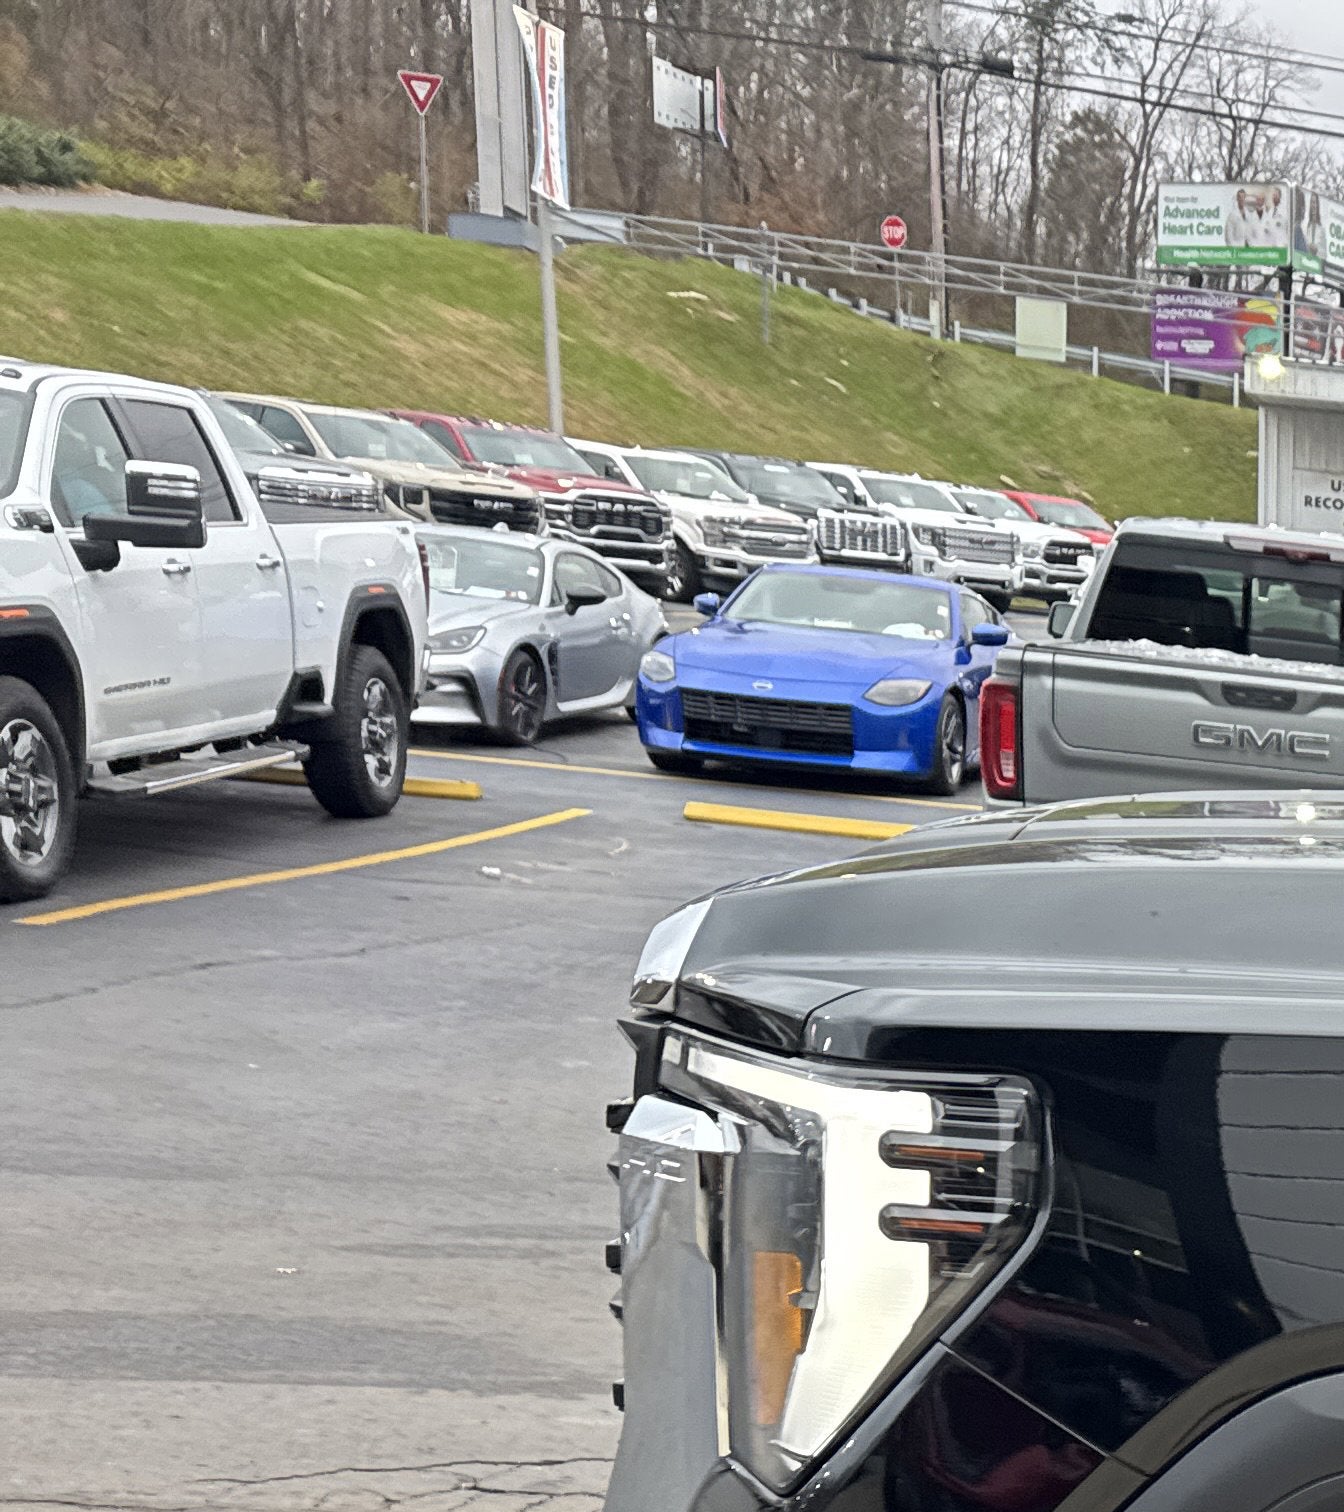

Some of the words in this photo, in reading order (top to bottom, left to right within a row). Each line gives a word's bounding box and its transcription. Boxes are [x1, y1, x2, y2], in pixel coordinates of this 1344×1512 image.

[1163, 205, 1220, 219] Advanced
[883, 225, 905, 239] STOP
[1162, 222, 1195, 235] Heart
[1196, 222, 1223, 235] Care
[1191, 720, 1330, 758] GMC
